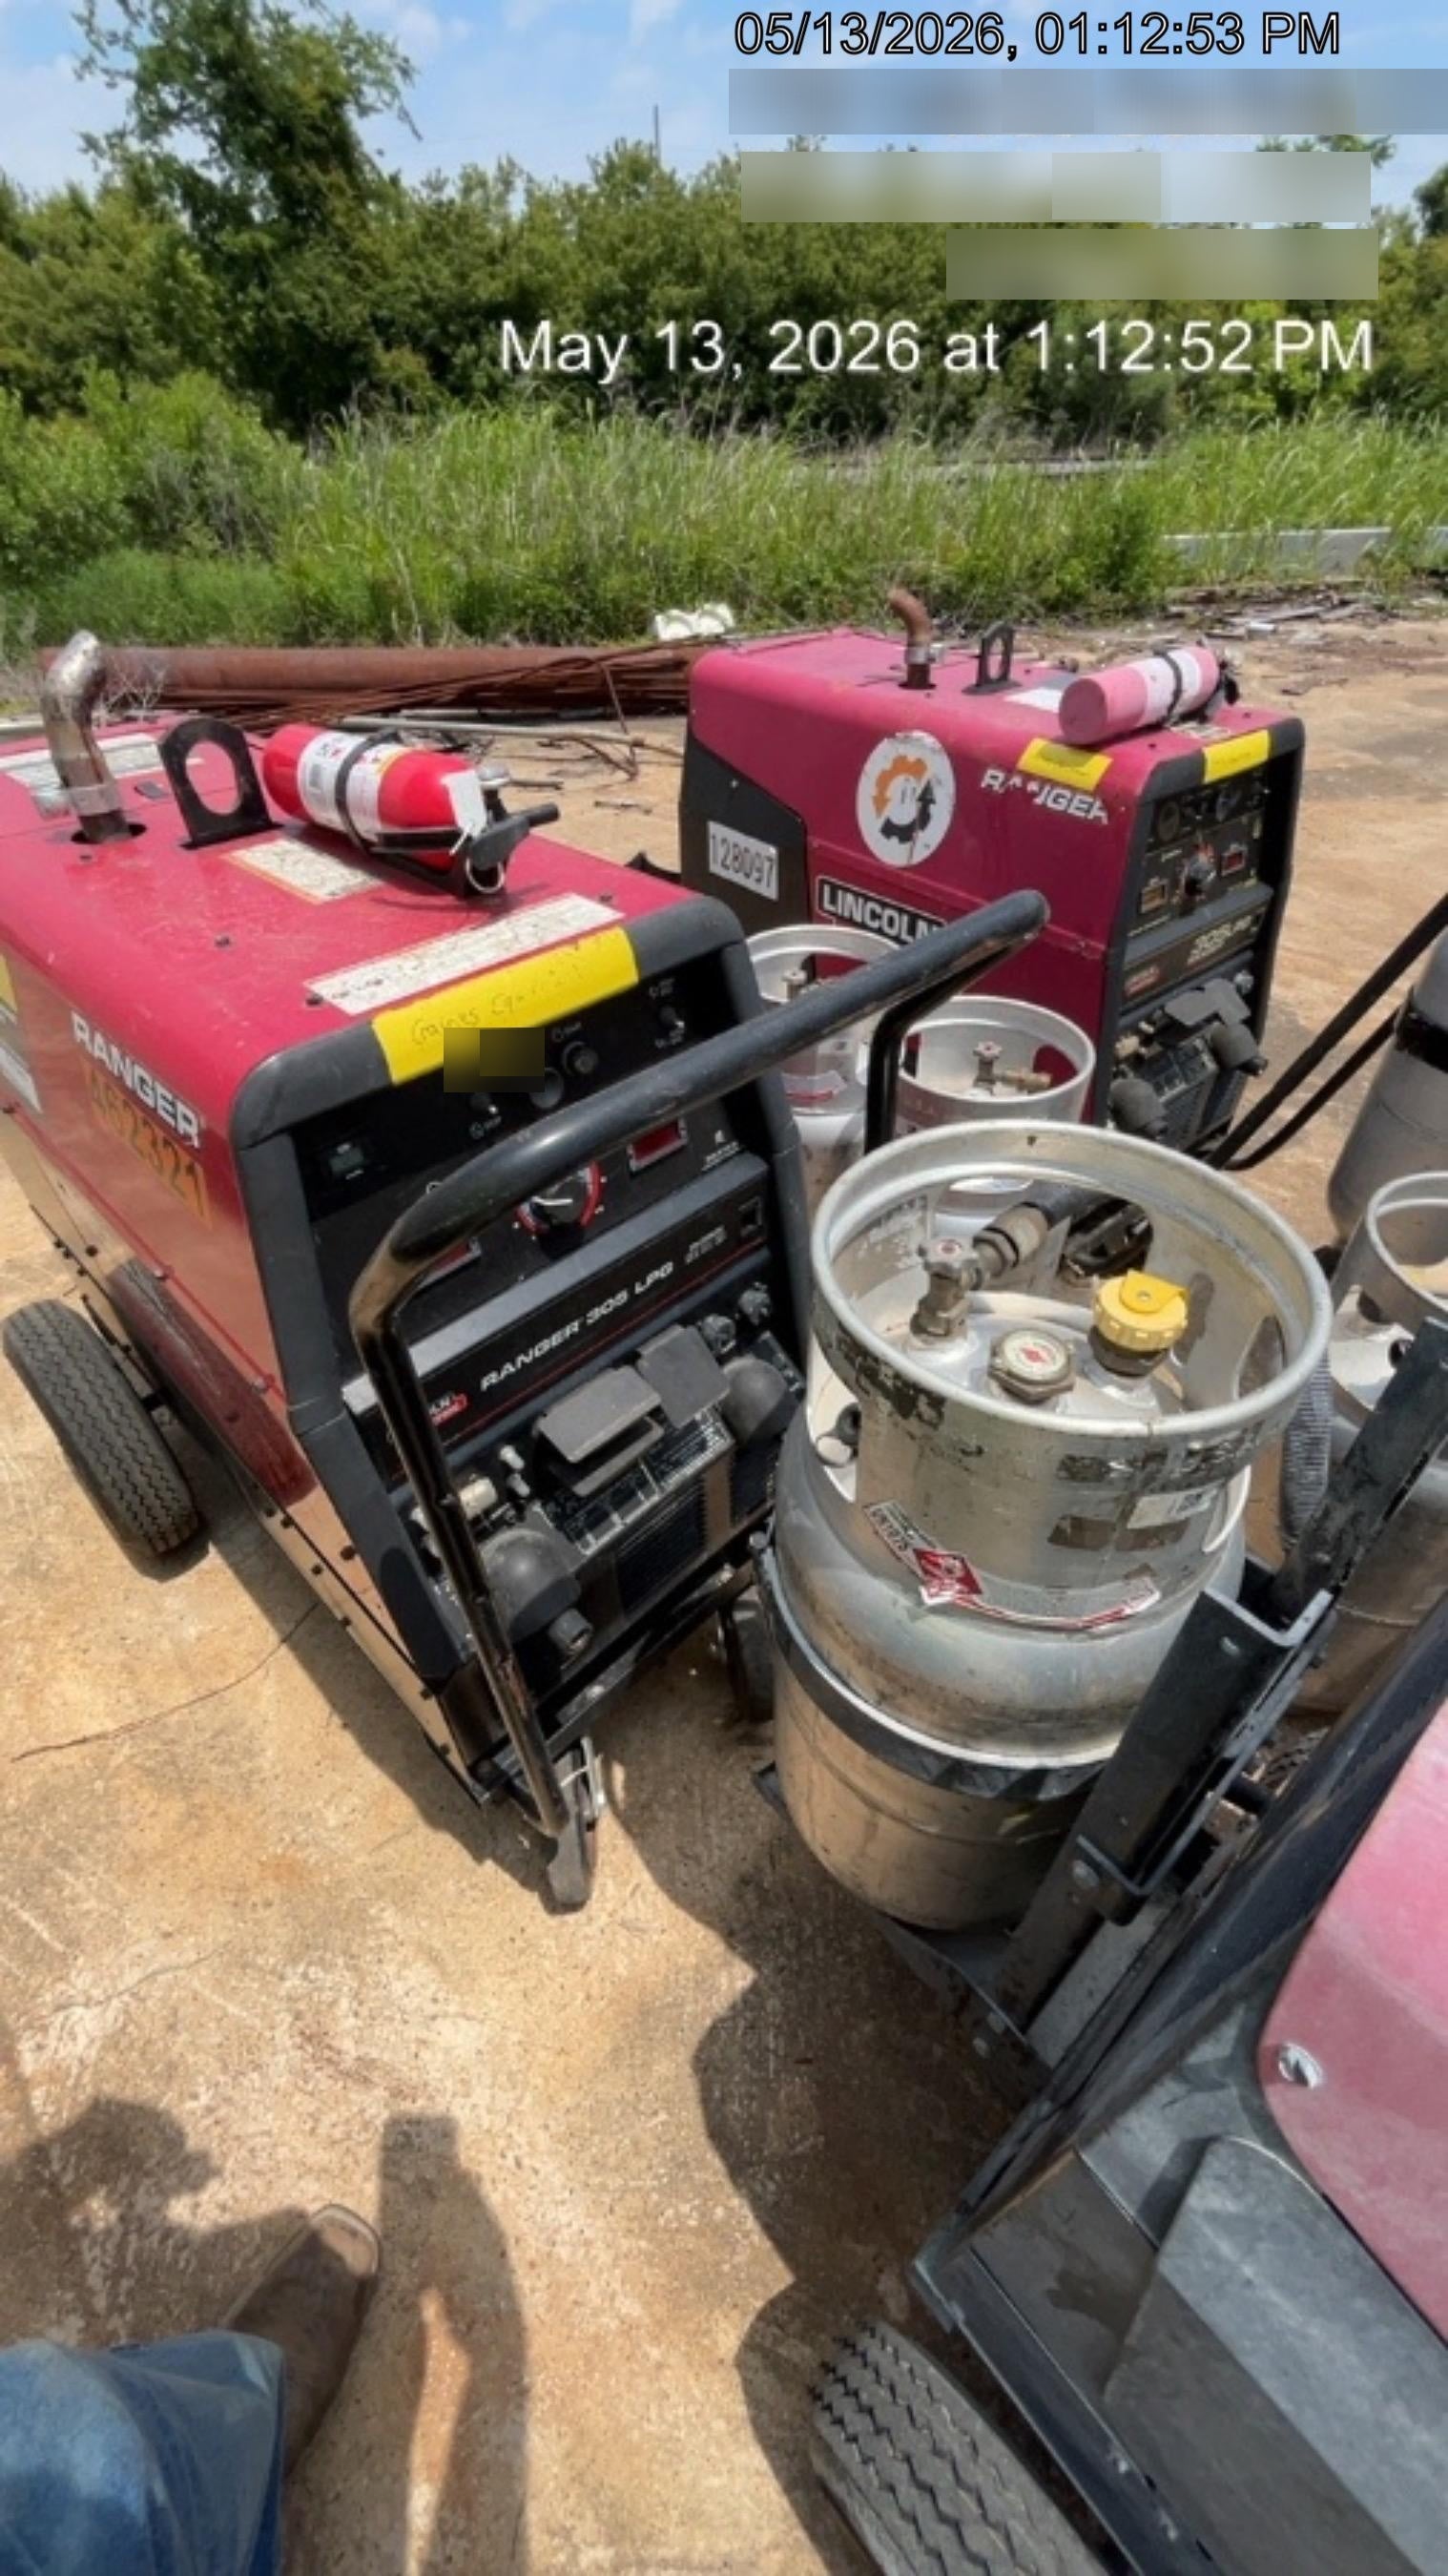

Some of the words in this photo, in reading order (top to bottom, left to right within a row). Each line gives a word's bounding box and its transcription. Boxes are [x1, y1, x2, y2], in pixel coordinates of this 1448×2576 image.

[72, 1009, 201, 1149] RANGER
[480, 1319, 579, 1392] RANGER
[585, 1288, 629, 1326] 305
[634, 1260, 674, 1295] LPG
